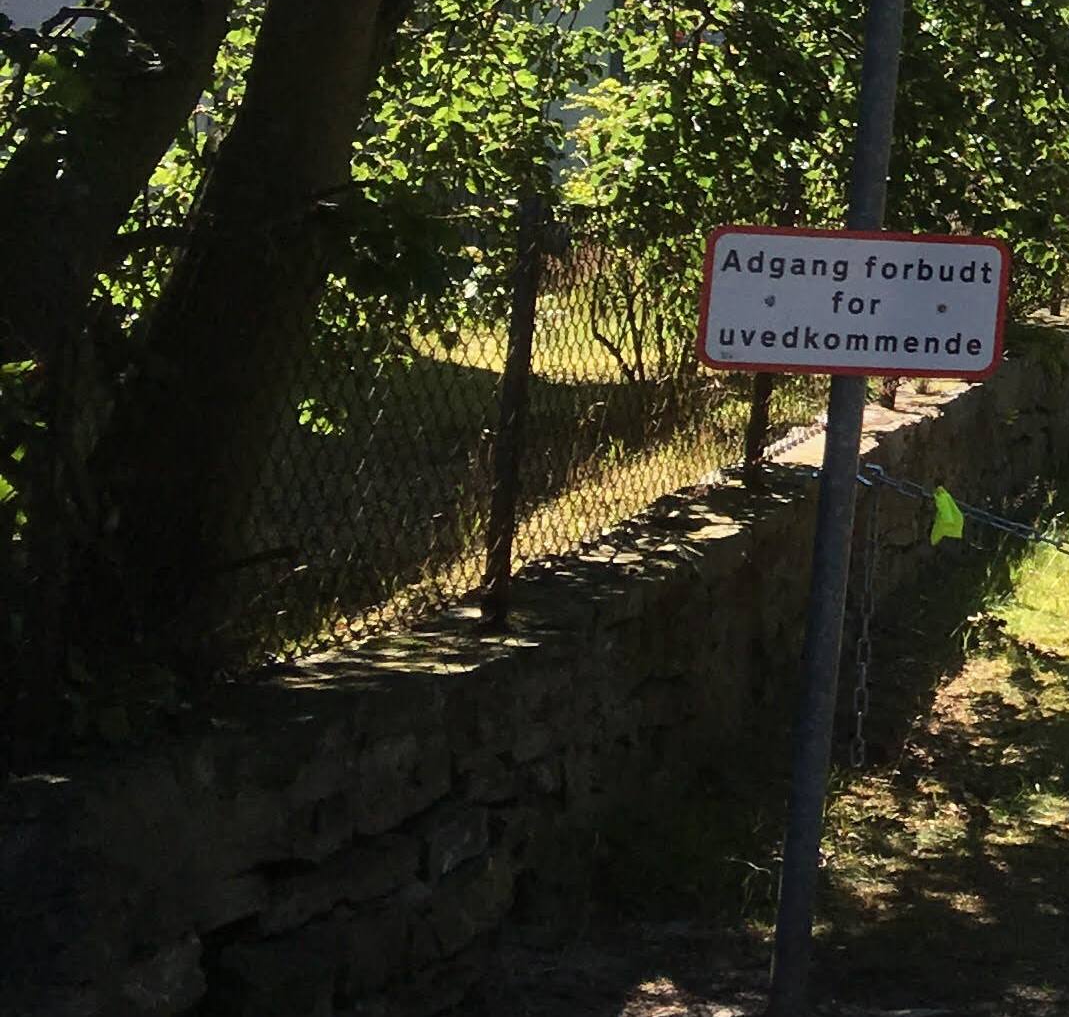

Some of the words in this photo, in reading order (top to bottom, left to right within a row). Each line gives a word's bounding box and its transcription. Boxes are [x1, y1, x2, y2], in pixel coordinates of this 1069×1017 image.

[720, 248, 849, 282] Adgang
[865, 255, 993, 284] forbudt
[832, 290, 881, 315] for
[718, 326, 983, 356] uvedkommende
